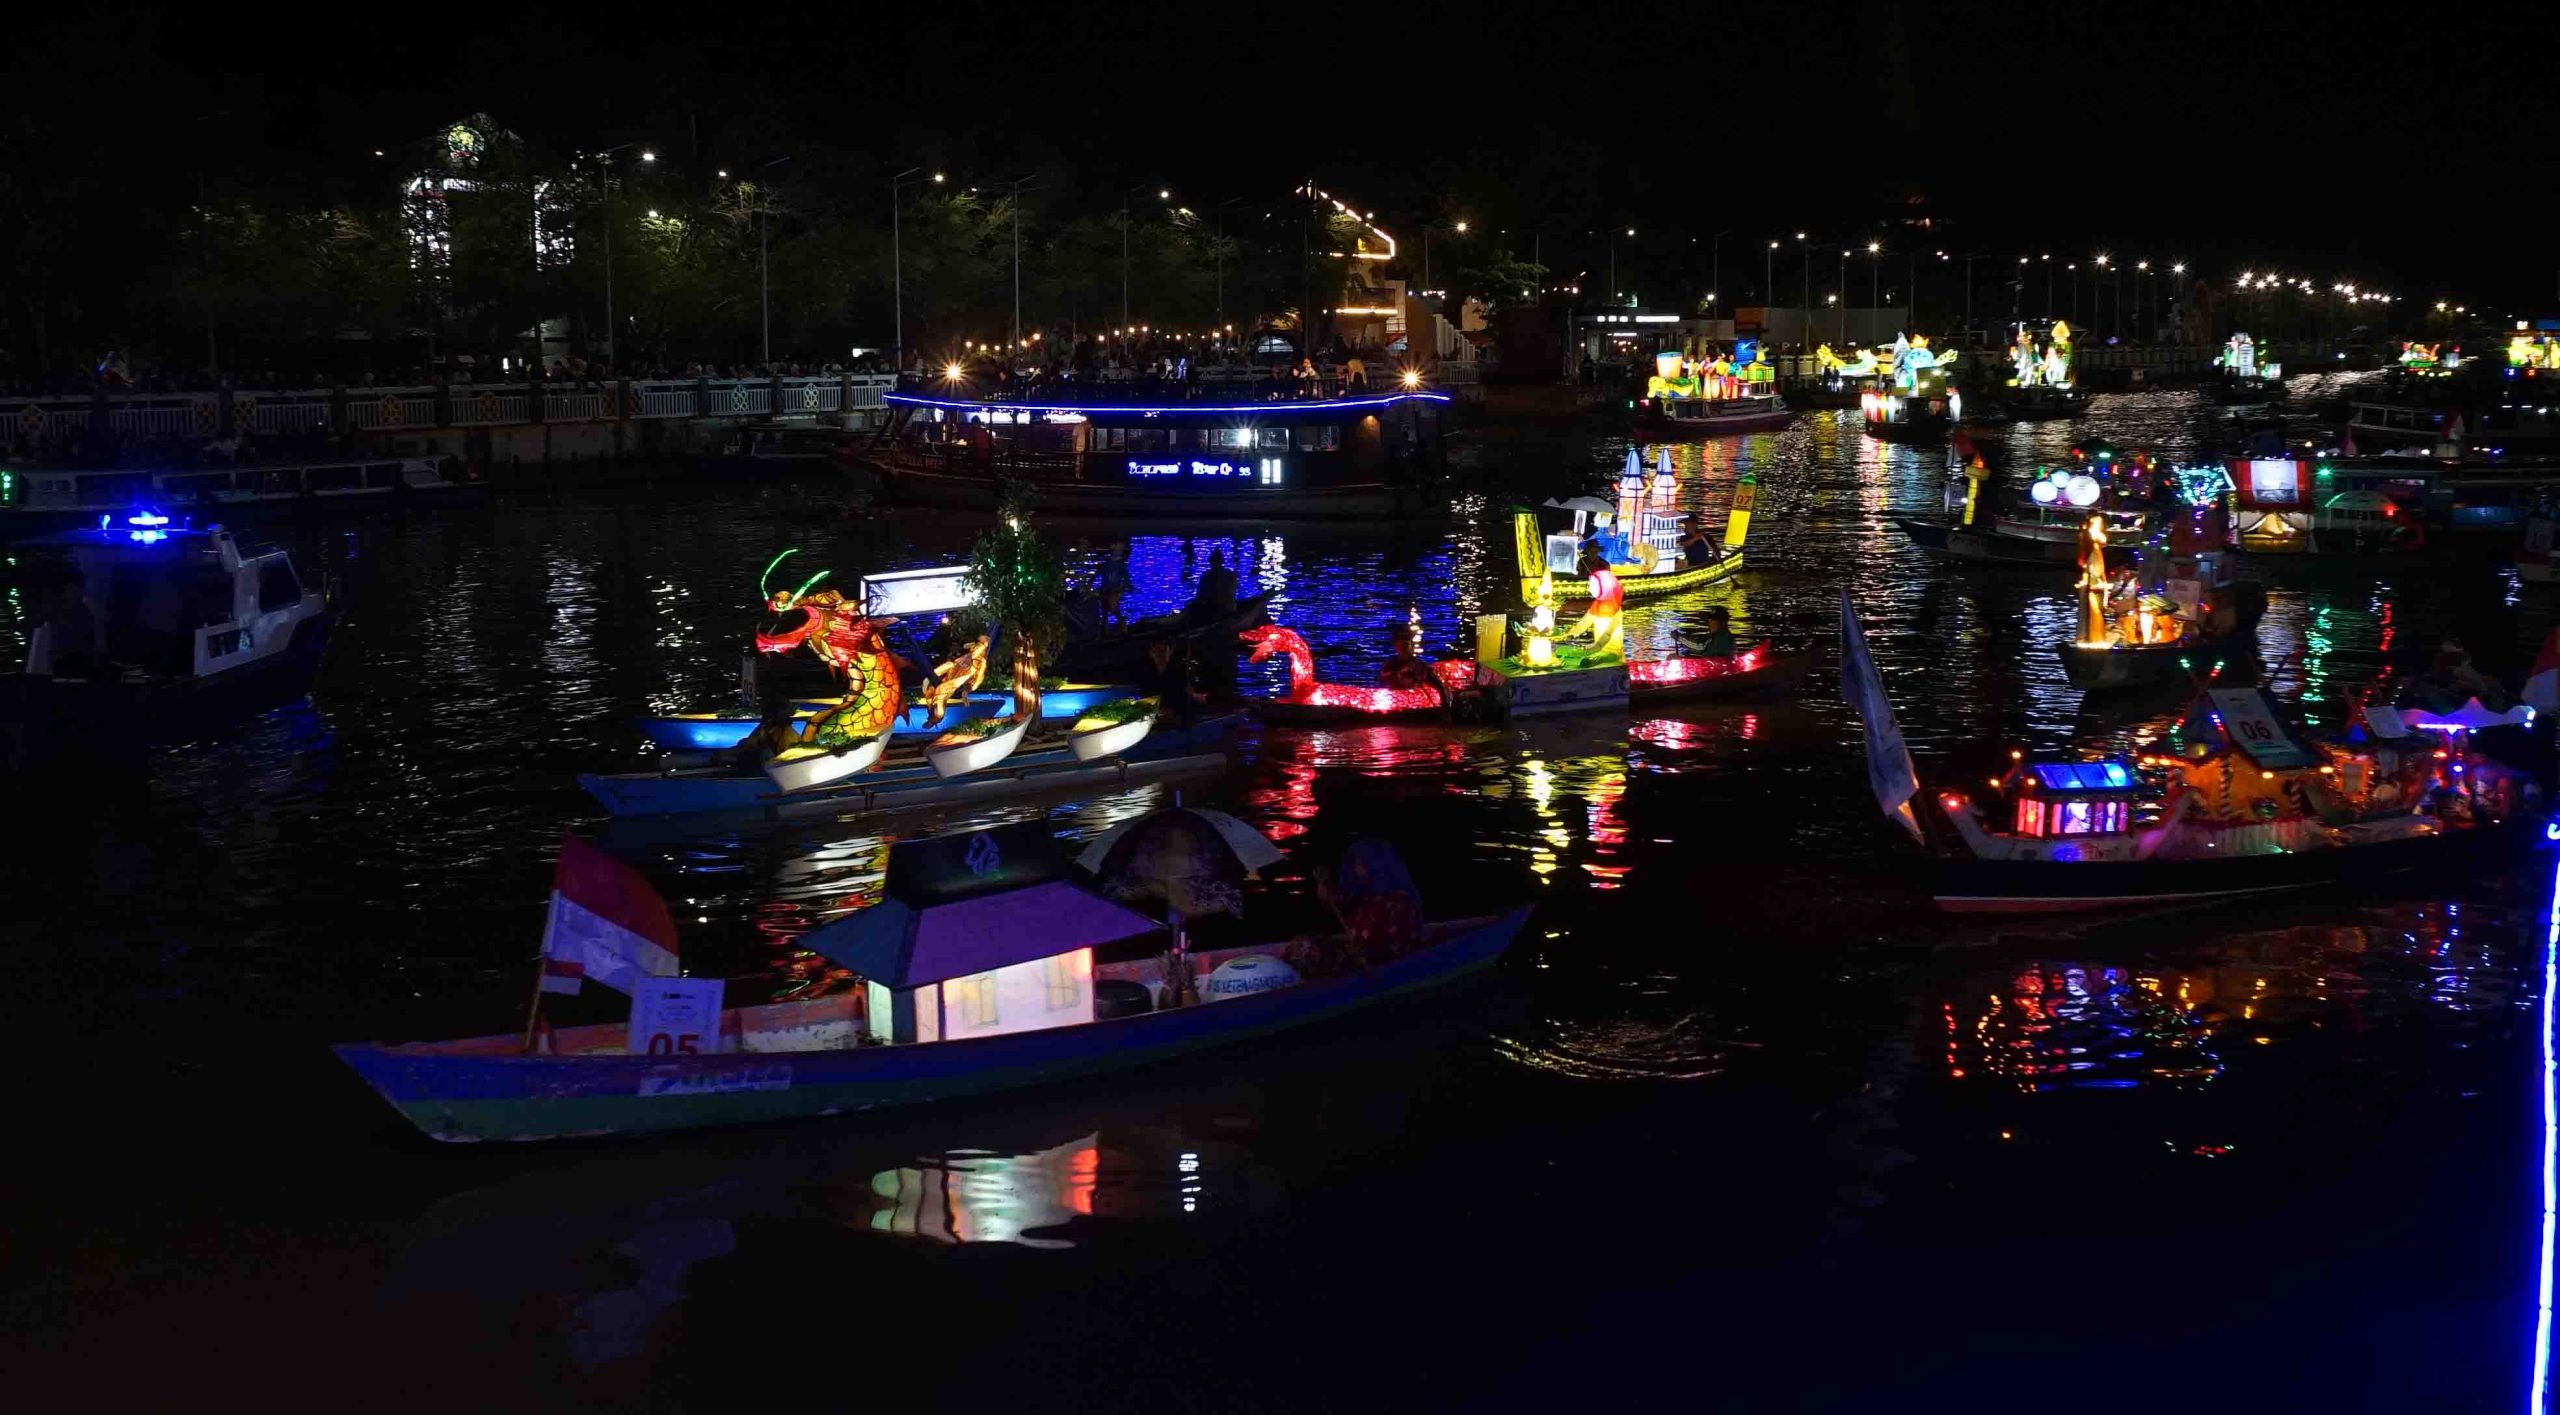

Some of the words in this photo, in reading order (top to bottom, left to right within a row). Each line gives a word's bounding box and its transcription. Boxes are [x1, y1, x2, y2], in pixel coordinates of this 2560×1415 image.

[1736, 494, 1752, 506] 07
[2239, 720, 2272, 740] 06
[648, 1032, 700, 1057] 05
